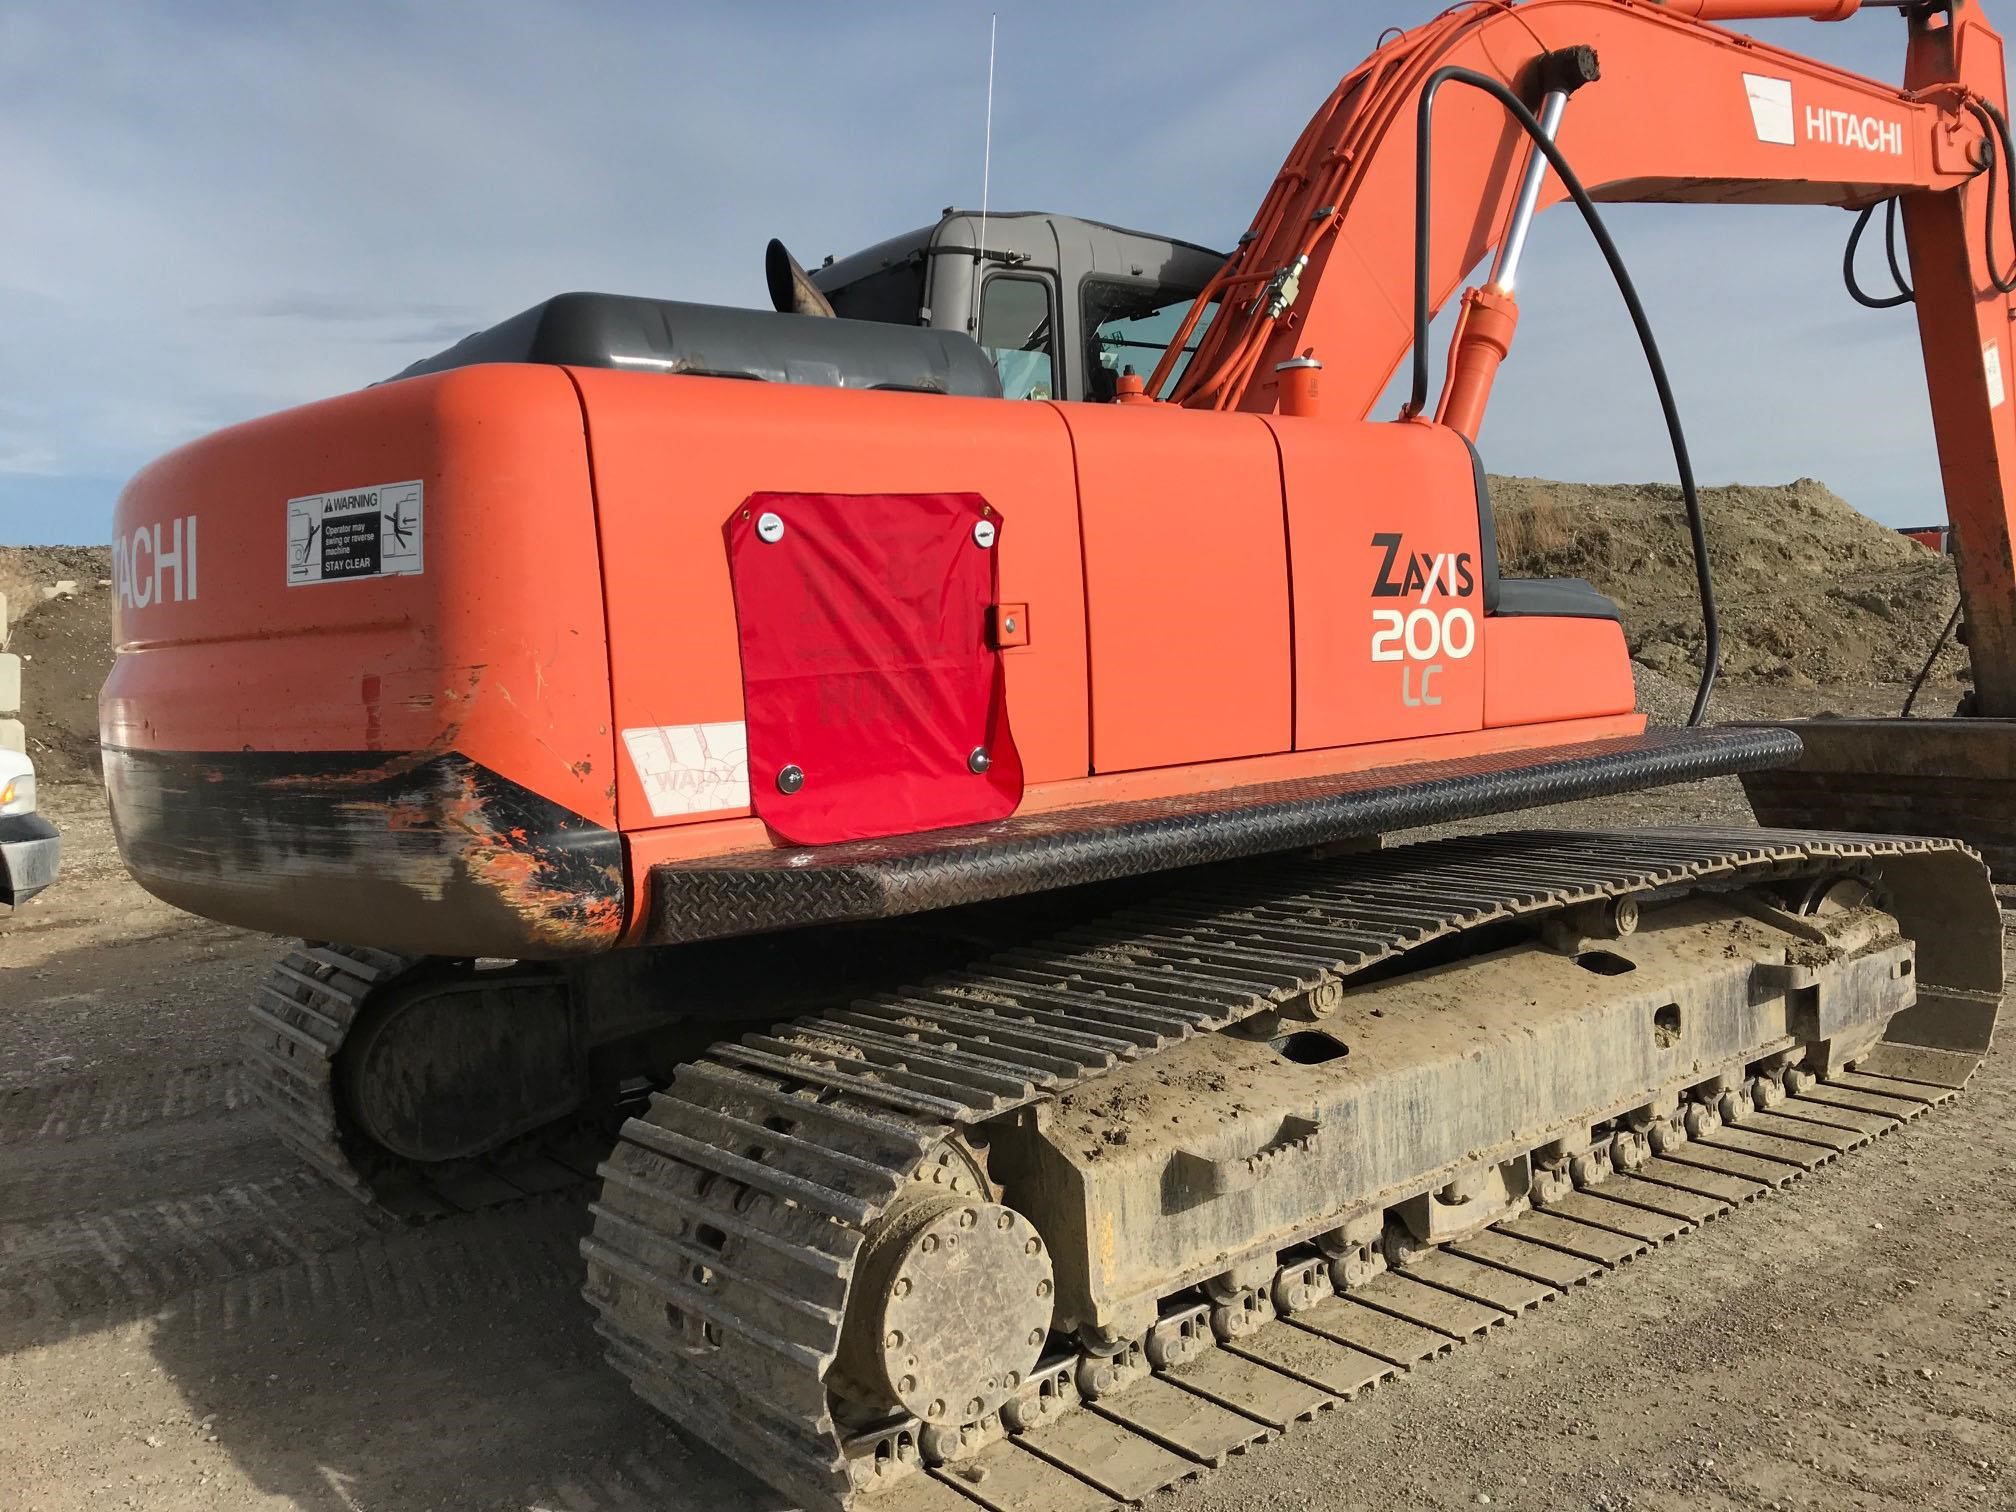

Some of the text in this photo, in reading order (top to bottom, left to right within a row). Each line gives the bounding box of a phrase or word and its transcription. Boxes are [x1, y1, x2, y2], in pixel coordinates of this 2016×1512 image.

[1805, 105, 1903, 155] HITACHI
[333, 493, 378, 511] WARNING
[325, 523, 366, 536] Operator may
[325, 533, 375, 547] swing or reverse
[325, 546, 351, 556] machine
[325, 557, 371, 572] STAY CLEAR
[1371, 533, 1474, 604] ZAXIS
[1372, 608, 1475, 662] 200
[1402, 665, 1443, 707] LC
